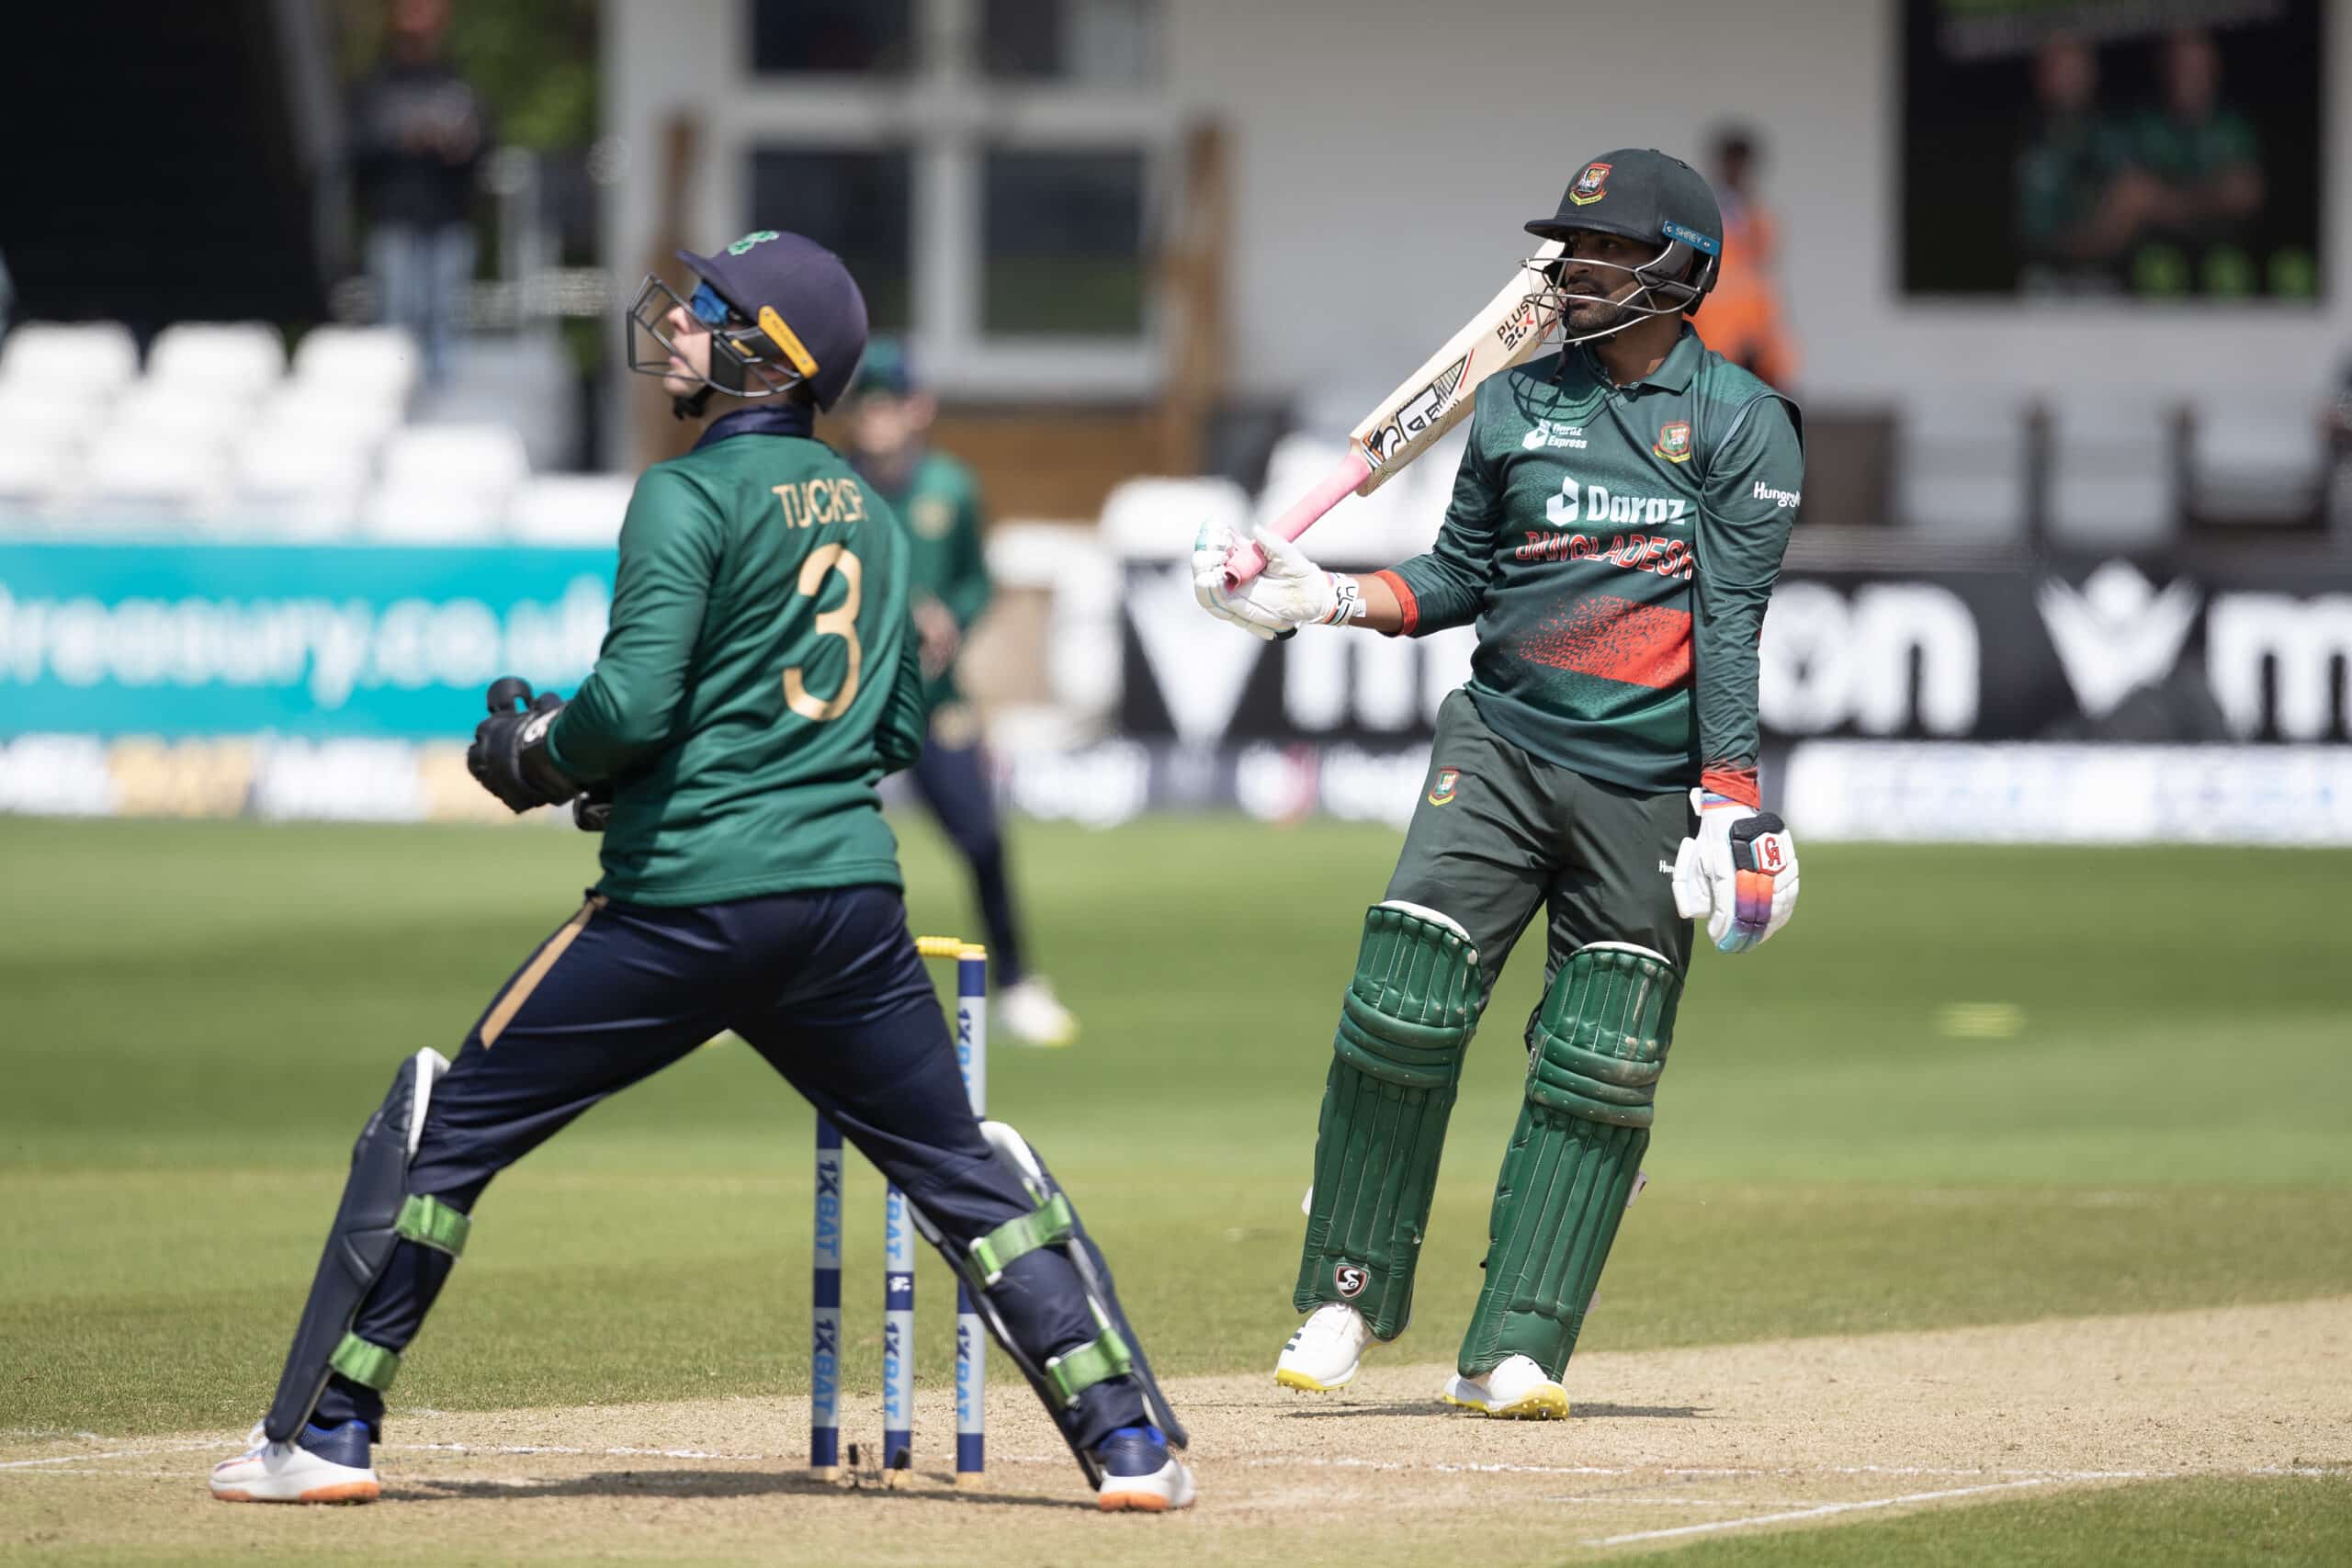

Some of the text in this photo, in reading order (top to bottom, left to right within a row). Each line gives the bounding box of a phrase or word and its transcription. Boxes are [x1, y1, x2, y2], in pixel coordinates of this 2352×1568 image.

[1497, 300, 1530, 341] PLUS
[1547, 435, 1588, 449] Express
[1553, 423, 1583, 436] Daraz
[771, 478, 869, 530] TUCKE
[1587, 485, 1686, 525] Daraz
[783, 542, 862, 721] 3
[816, 1160, 838, 1258] 1XBAT
[813, 1319, 836, 1416] 1XBAT
